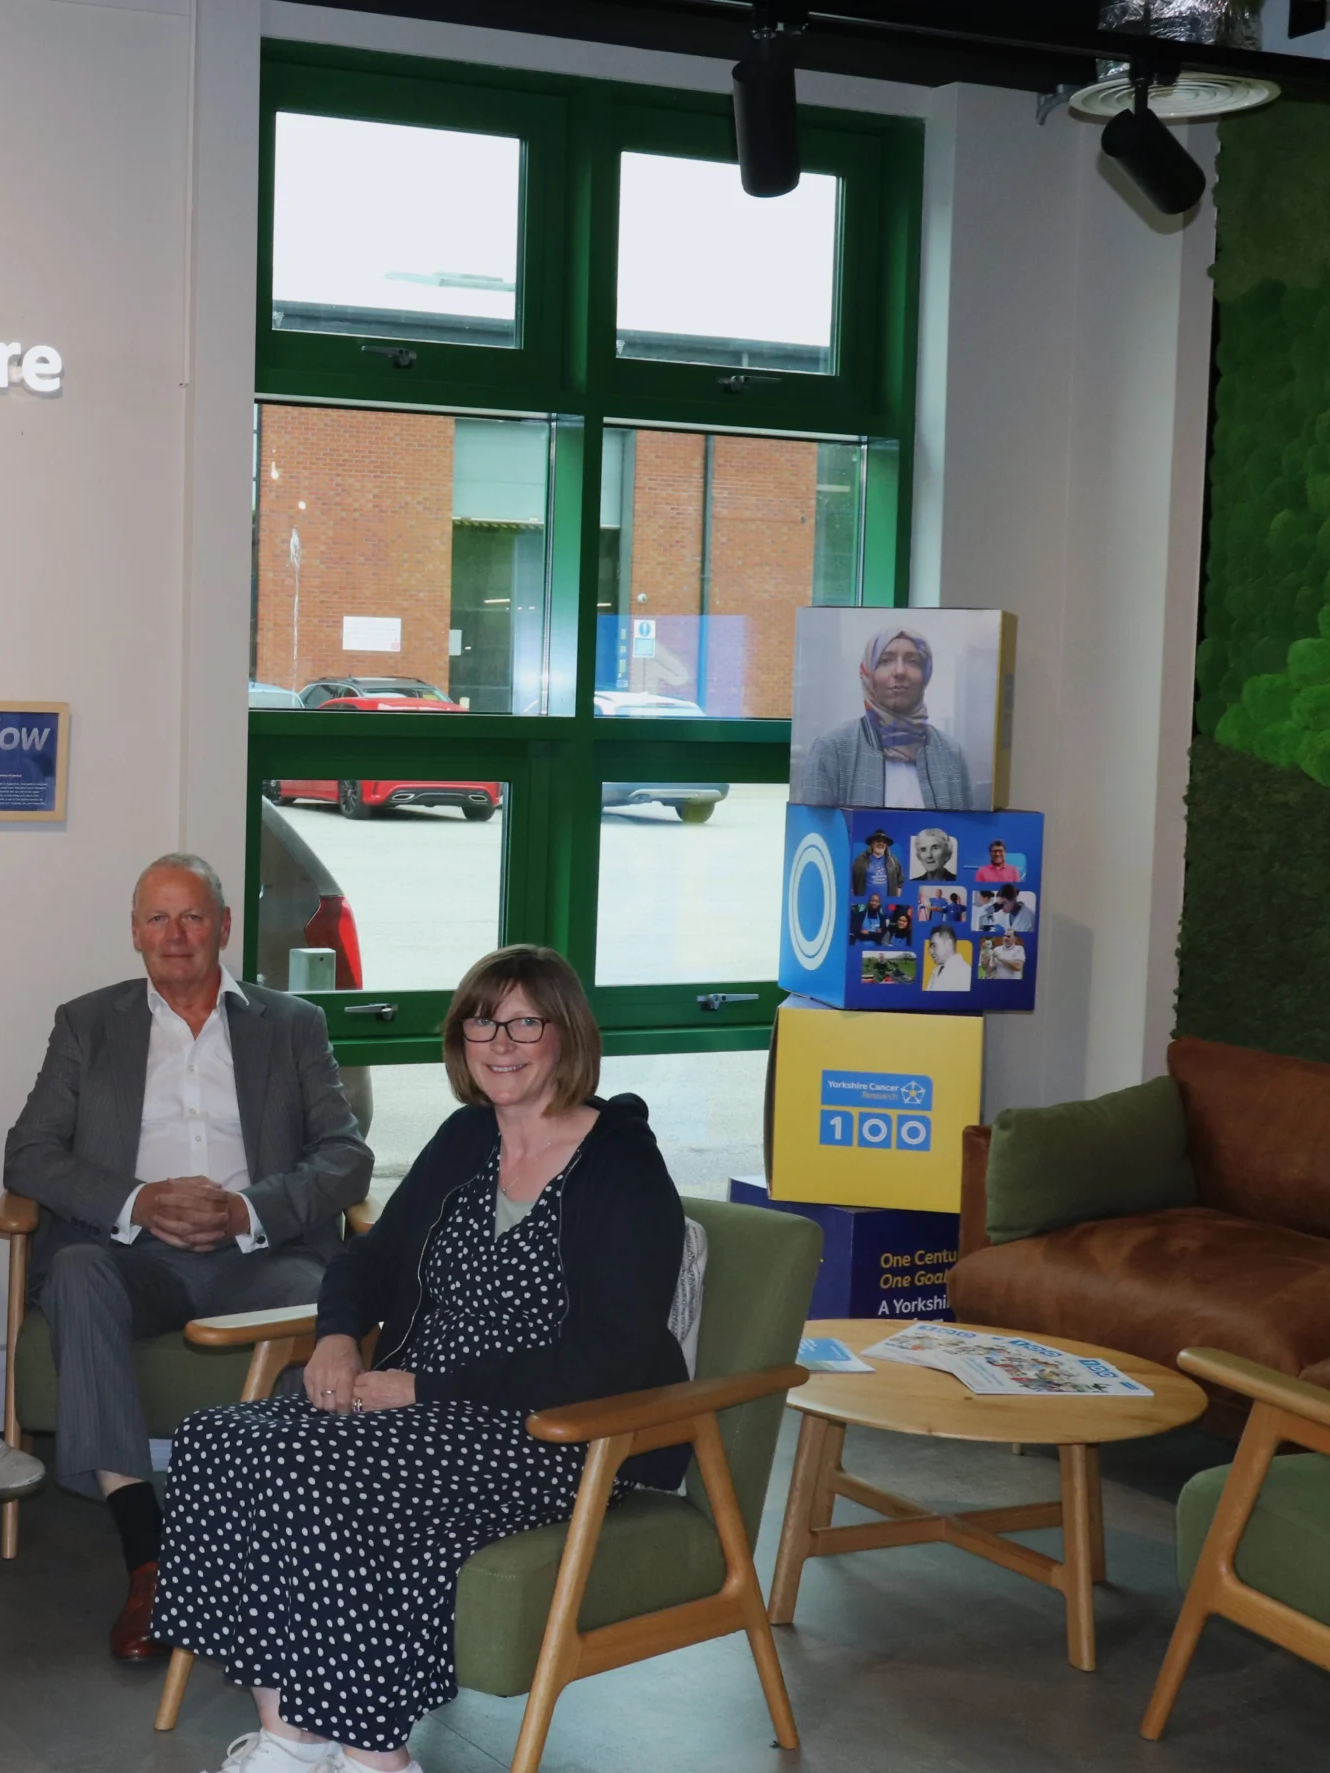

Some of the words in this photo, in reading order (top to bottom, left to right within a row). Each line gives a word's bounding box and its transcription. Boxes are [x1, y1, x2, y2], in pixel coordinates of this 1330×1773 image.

[828, 1081, 868, 1090] Yorkshire
[869, 1083, 899, 1092] Cancer
[830, 1116, 927, 1145] 100
[880, 1253, 911, 1269] One
[879, 1273, 911, 1289] One
[914, 1268, 949, 1286] Goal
[878, 1300, 890, 1316] A
